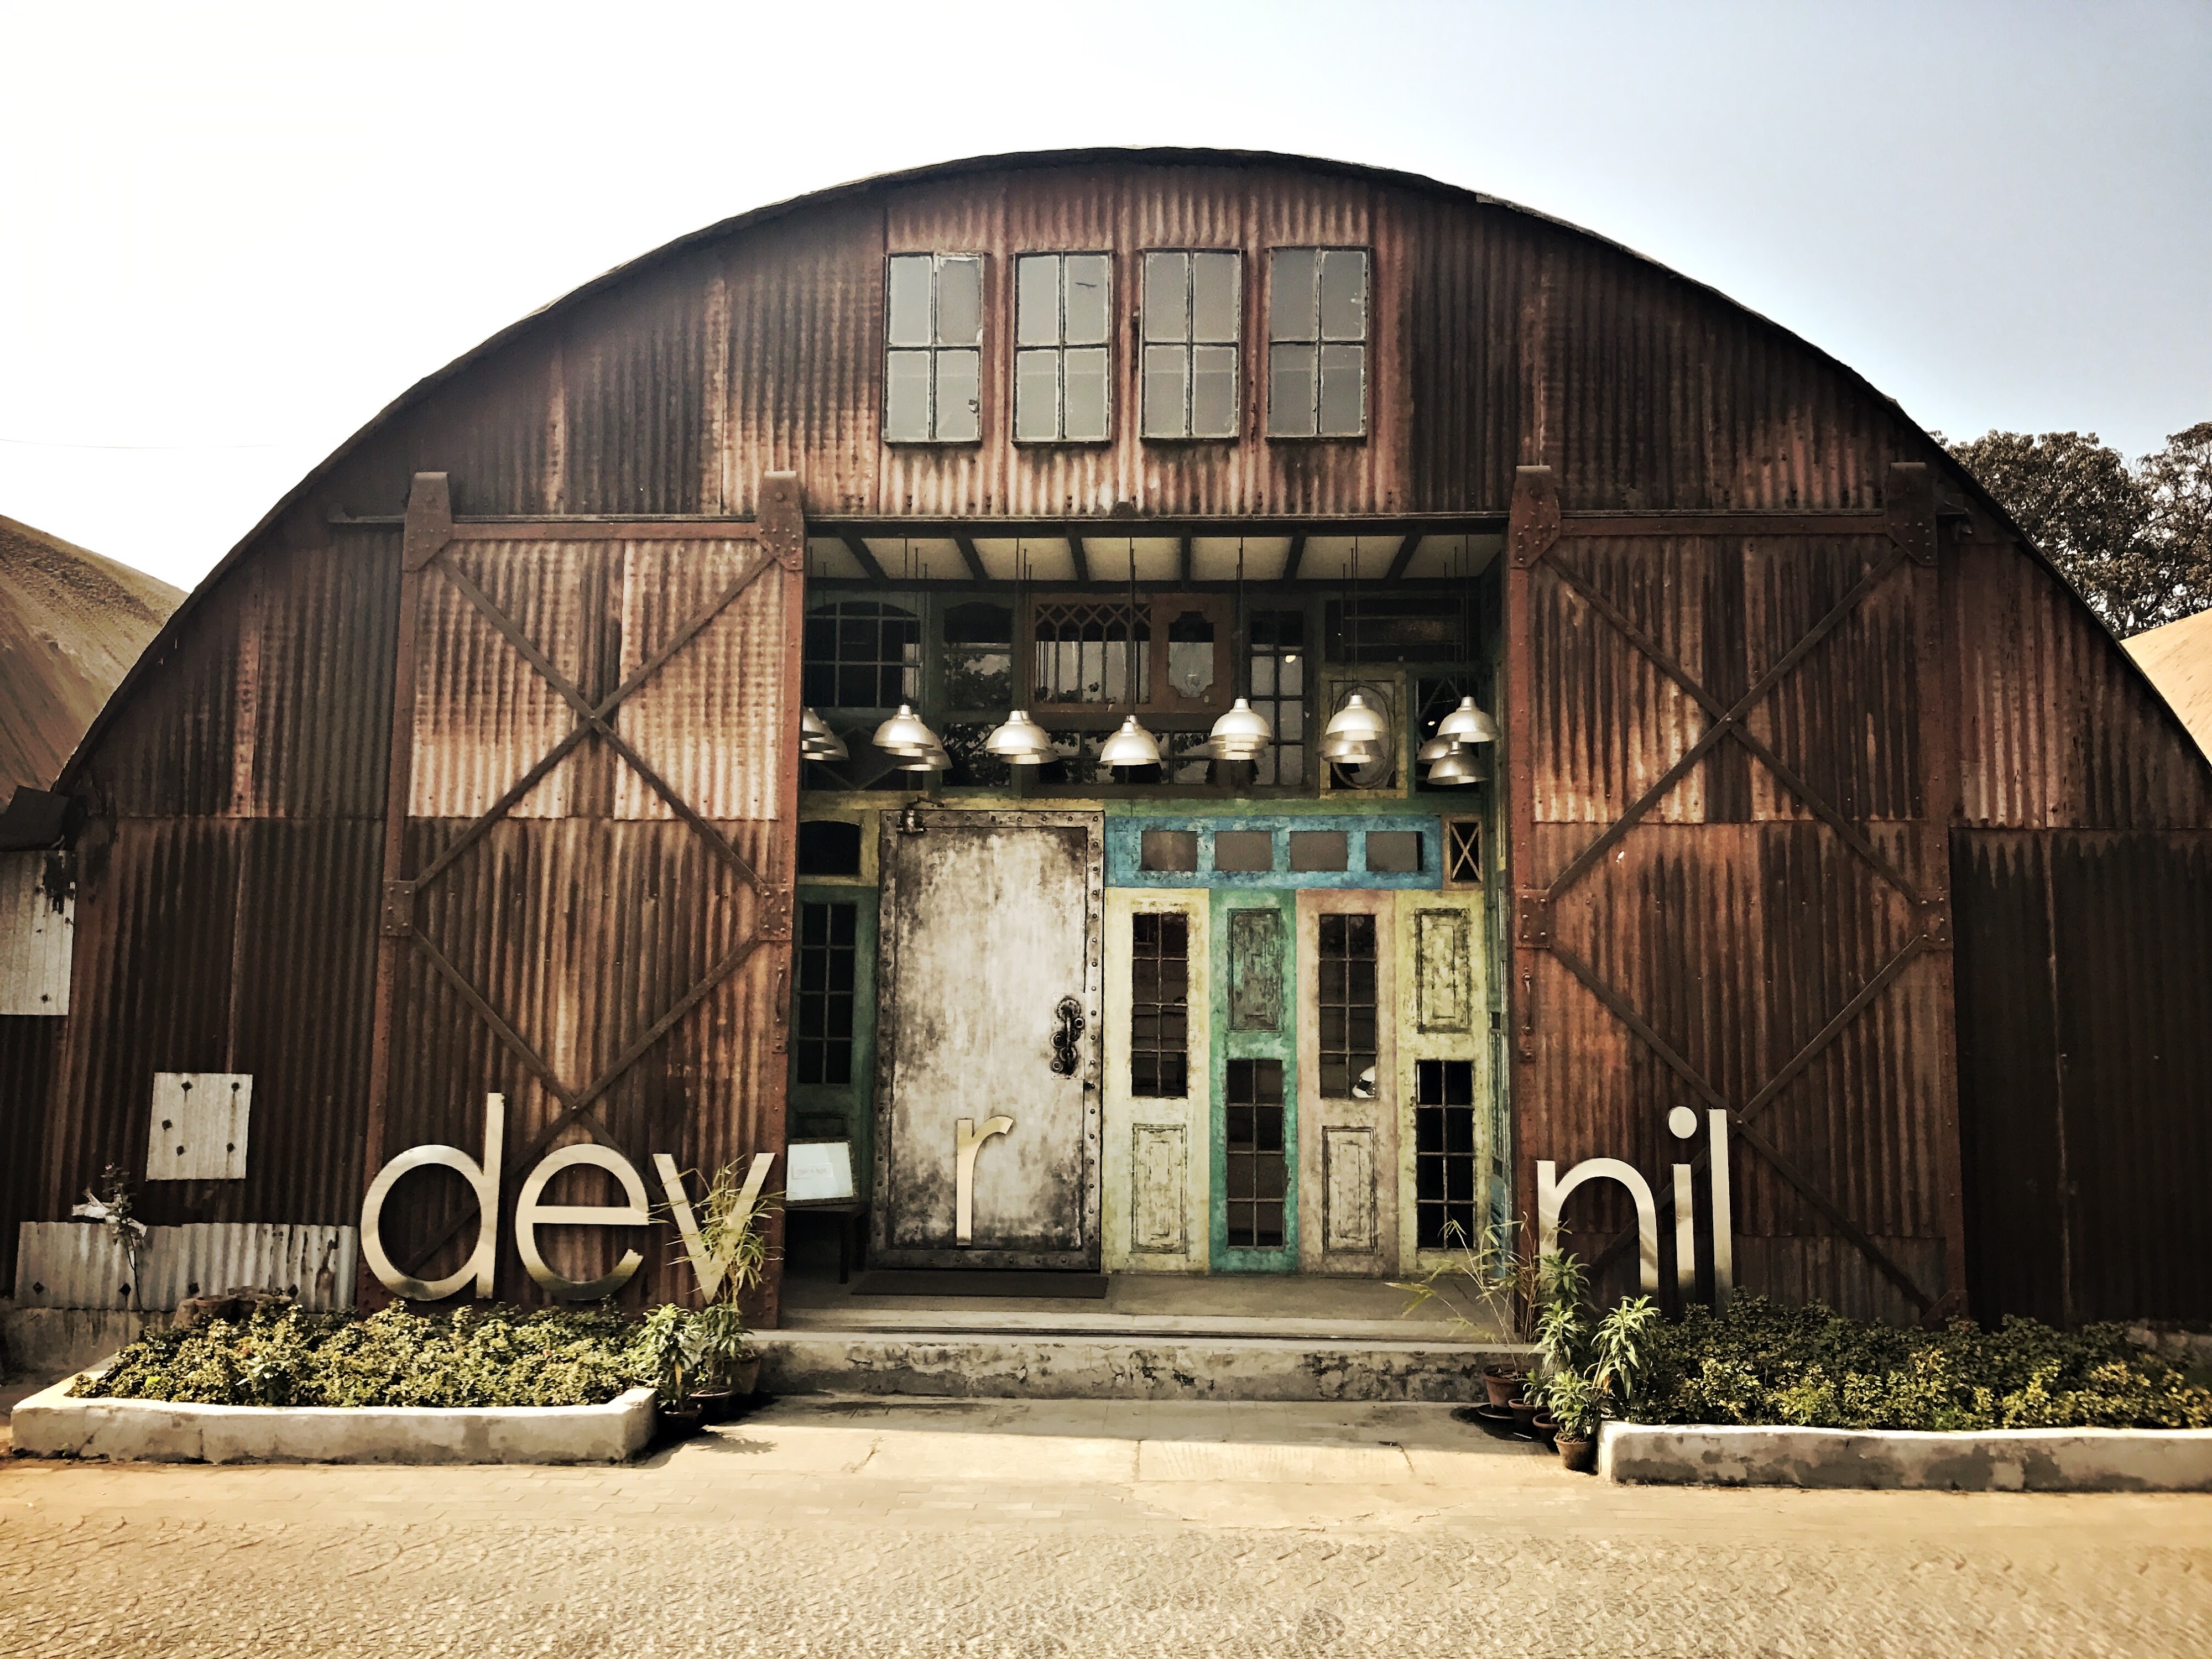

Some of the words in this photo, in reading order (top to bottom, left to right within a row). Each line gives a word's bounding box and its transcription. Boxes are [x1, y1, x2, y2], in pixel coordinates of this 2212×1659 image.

[361, 1092, 775, 1303] dev
[956, 1115, 1014, 1246] r
[1537, 1106, 1733, 1319] nil
